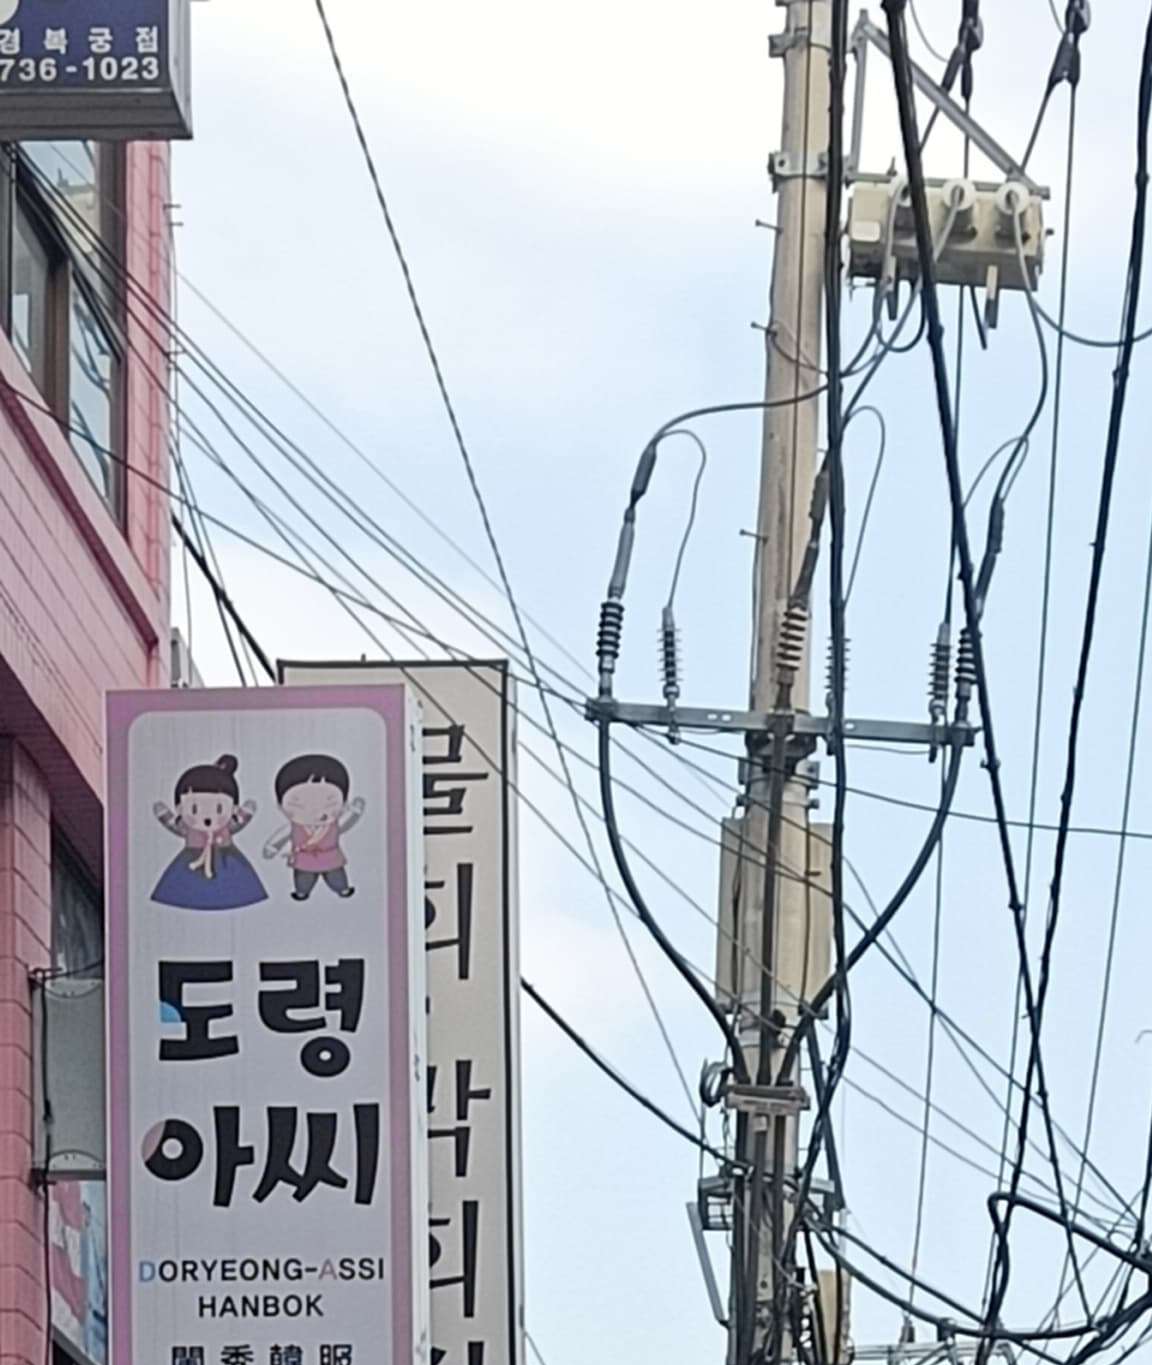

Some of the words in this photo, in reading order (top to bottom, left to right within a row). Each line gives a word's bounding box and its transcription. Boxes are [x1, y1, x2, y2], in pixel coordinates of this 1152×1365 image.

[158, 958, 366, 1077] 도령
[142, 1103, 381, 1207] 아씨
[139, 1257, 385, 1283] DORYEONG-ASSI
[198, 1294, 325, 1318] HANBOK
